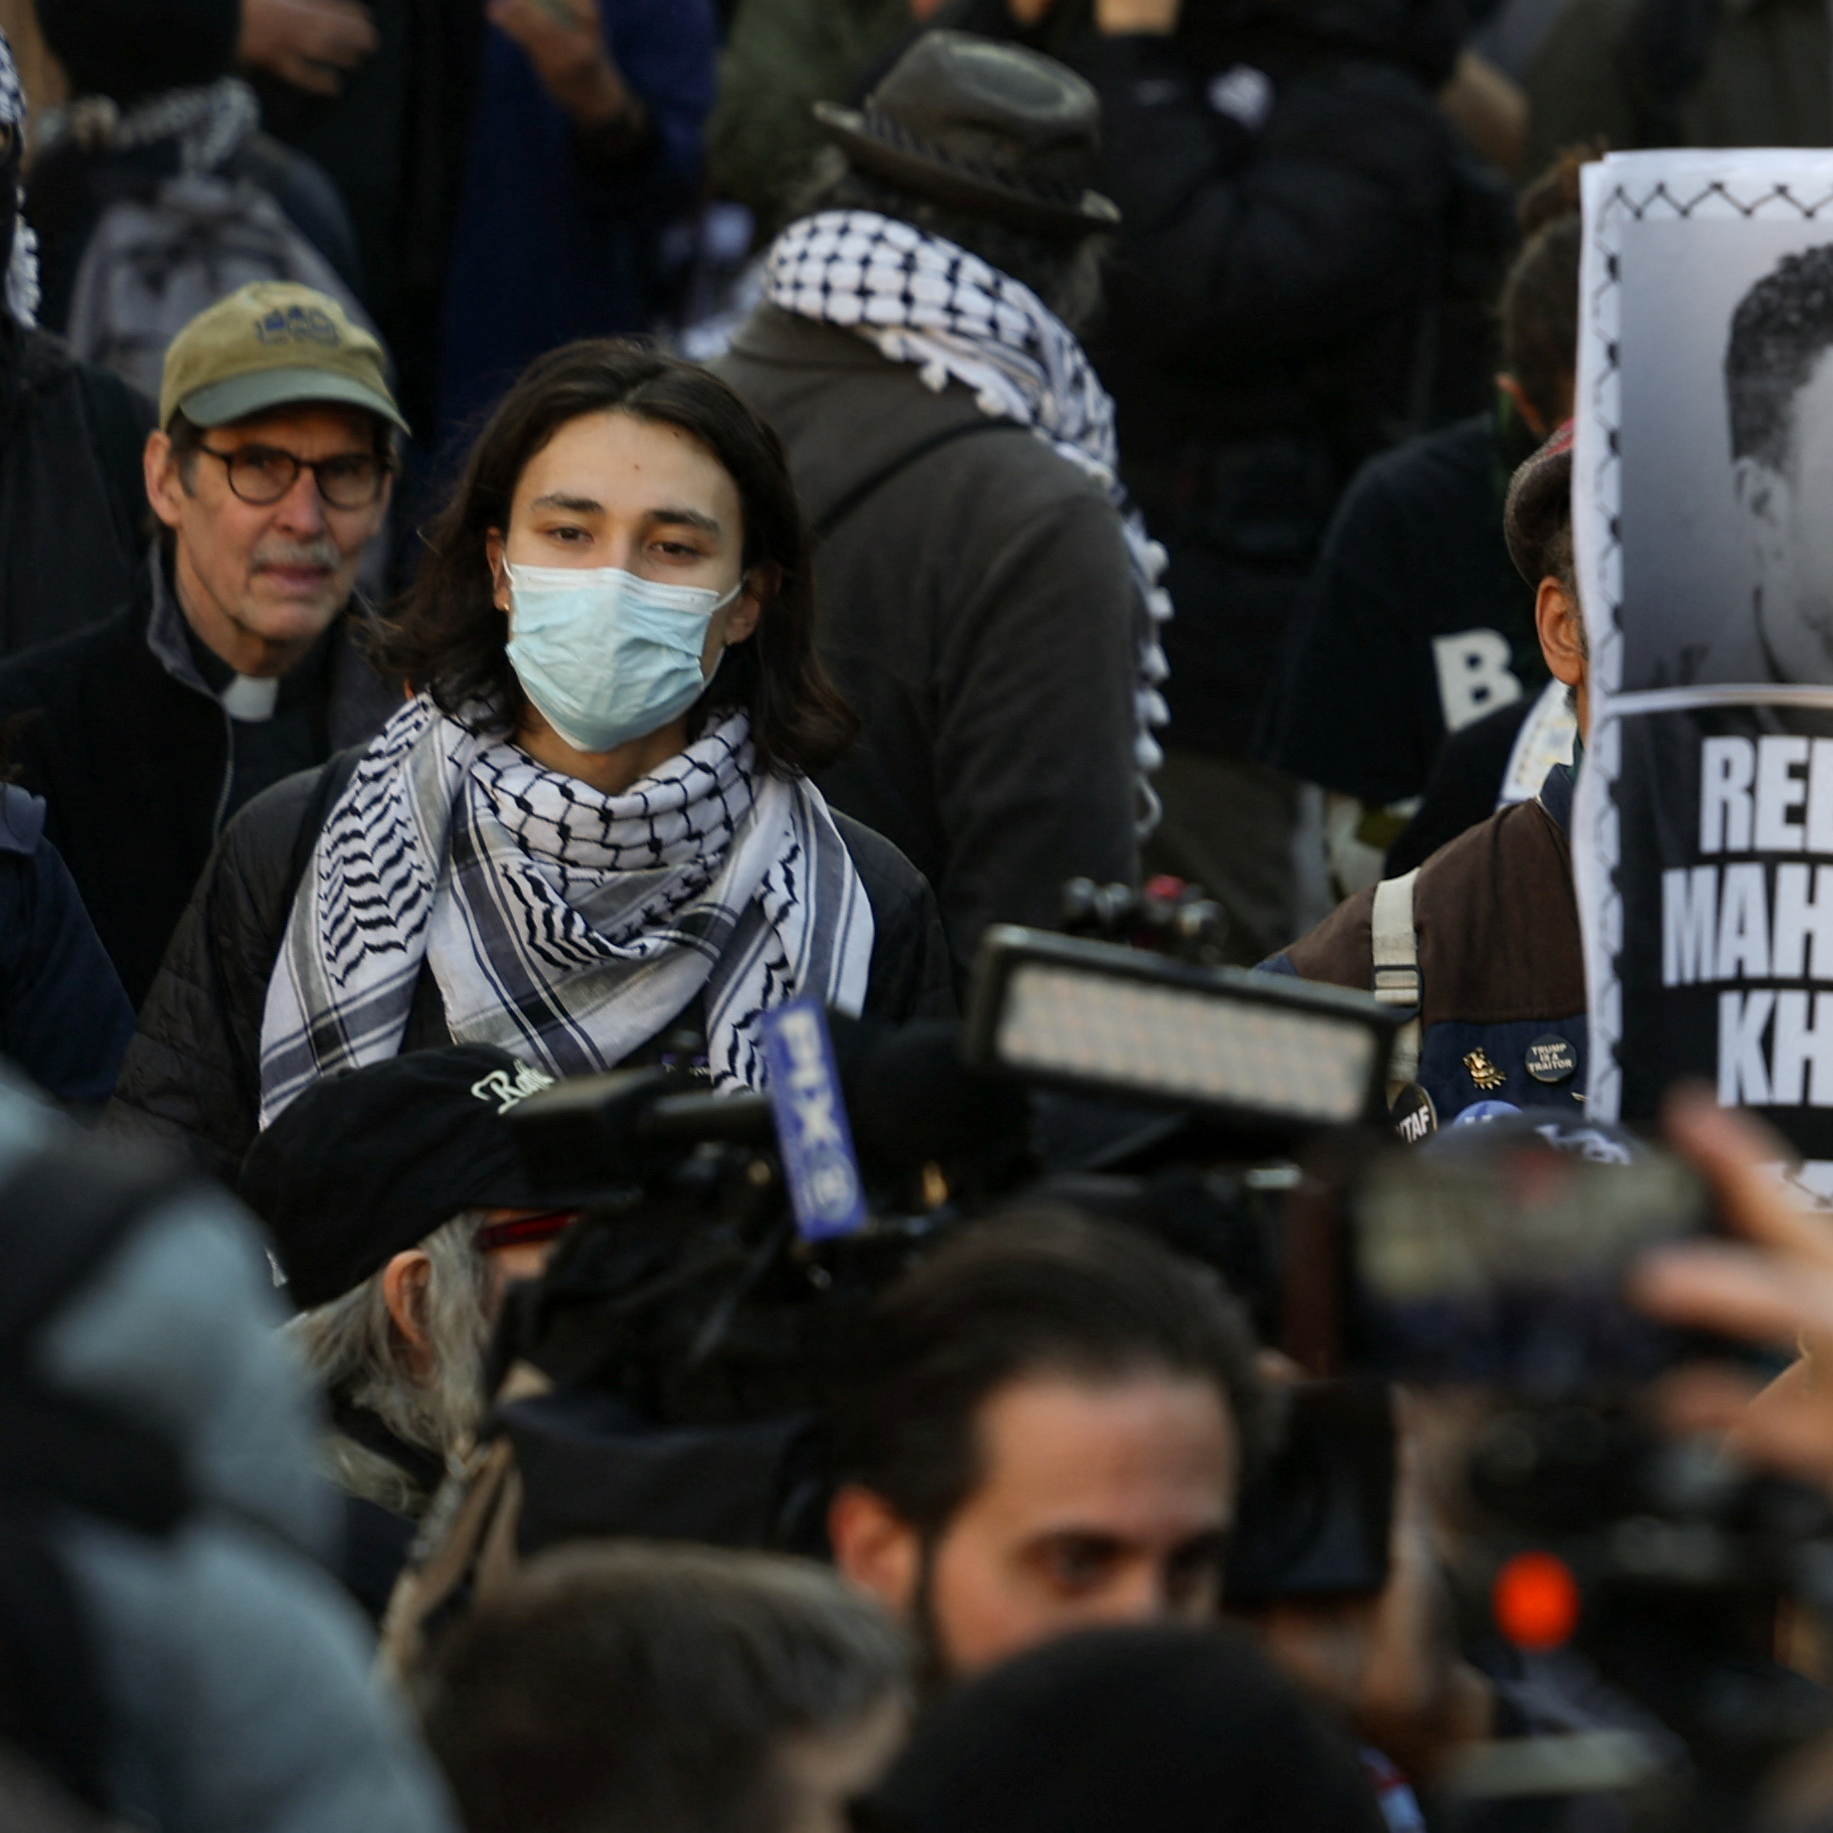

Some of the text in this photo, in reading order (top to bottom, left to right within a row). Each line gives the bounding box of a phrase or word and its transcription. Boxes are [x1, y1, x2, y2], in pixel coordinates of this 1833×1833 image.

[1531, 1043, 1567, 1055] TRUMP
[1539, 1052, 1560, 1062] IS A
[1528, 1059, 1573, 1072] TRAITOR
